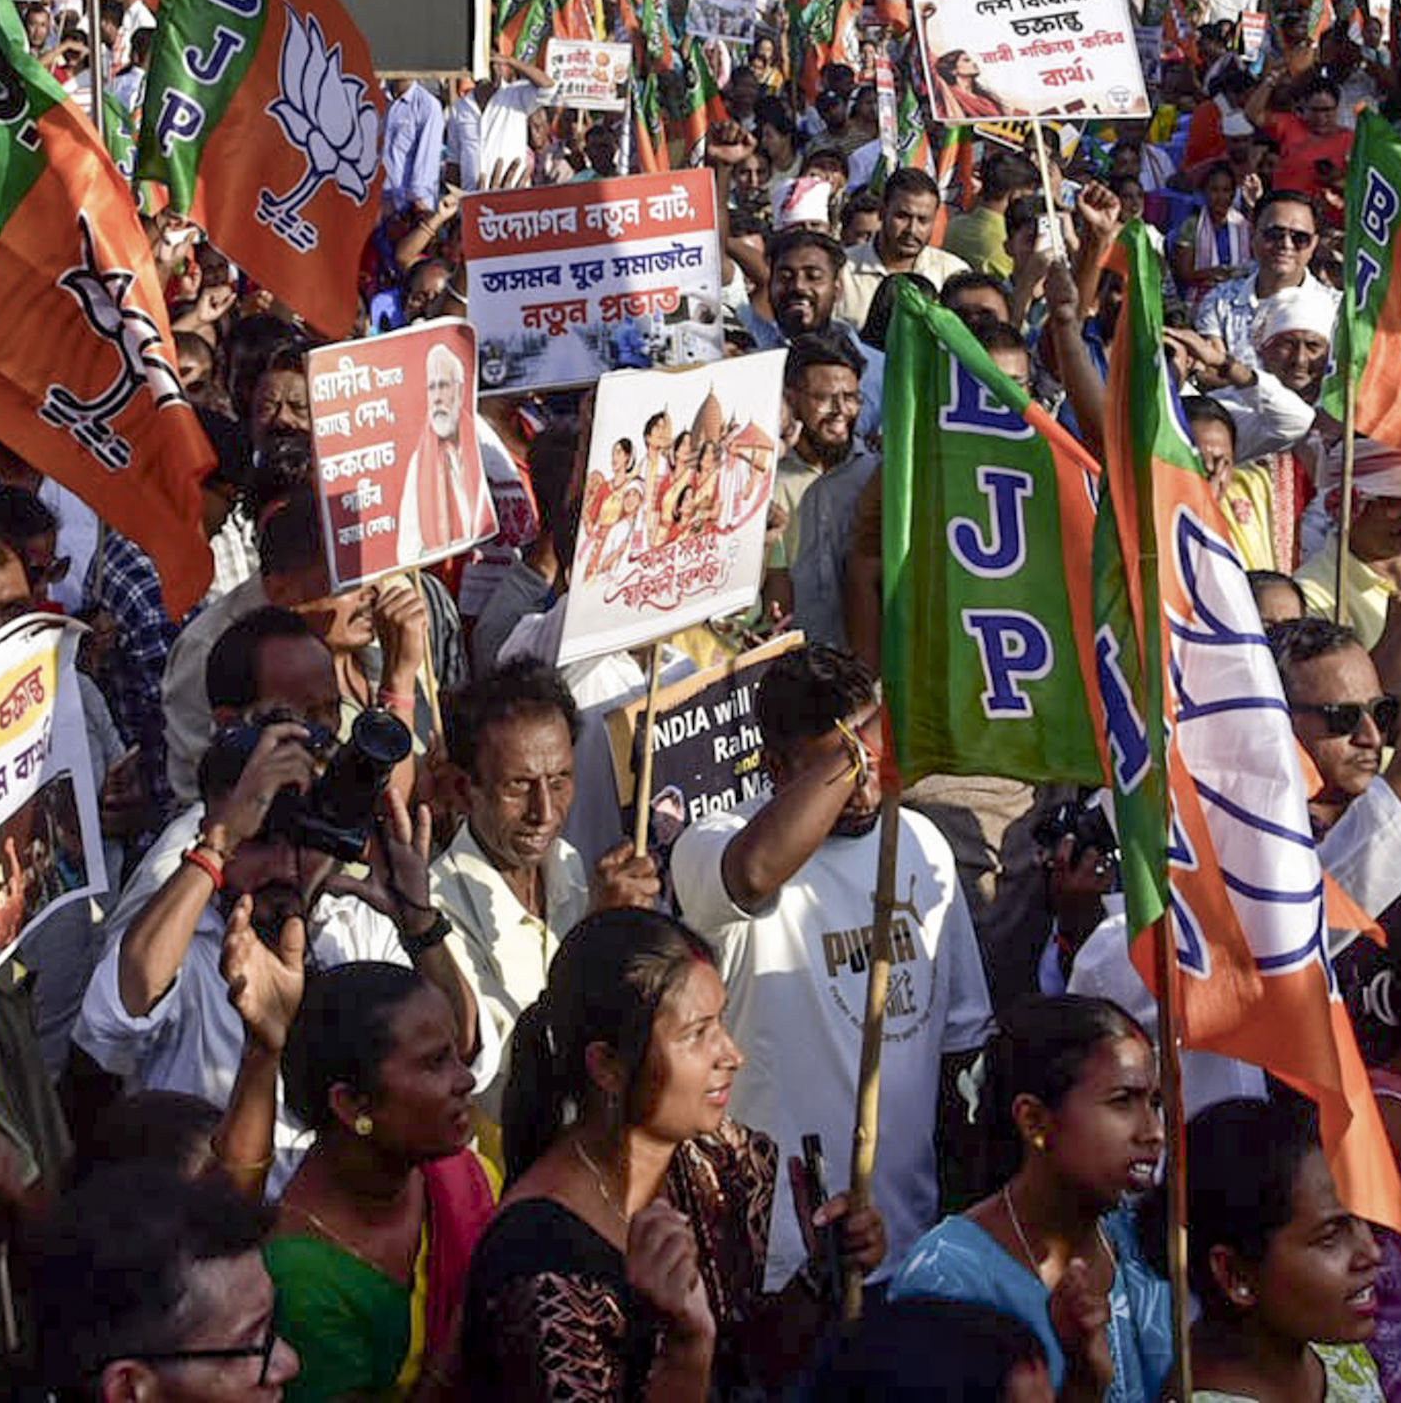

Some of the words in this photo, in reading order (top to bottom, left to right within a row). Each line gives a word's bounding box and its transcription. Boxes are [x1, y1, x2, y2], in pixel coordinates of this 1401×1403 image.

[477, 204, 578, 243] উদ্যোগৰ
[584, 198, 641, 238] নতুন
[646, 185, 697, 222] বাট,
[481, 263, 563, 294] অসমৰ
[611, 241, 704, 278] সমাজলৈ
[520, 298, 588, 337] নতুন
[598, 286, 680, 324] প্ৰভাত
[313, 355, 372, 403] মোদীৰ
[650, 705, 712, 754] NDIA
[713, 685, 751, 726] will
[732, 748, 762, 776] and
[821, 917, 918, 978] PUA
